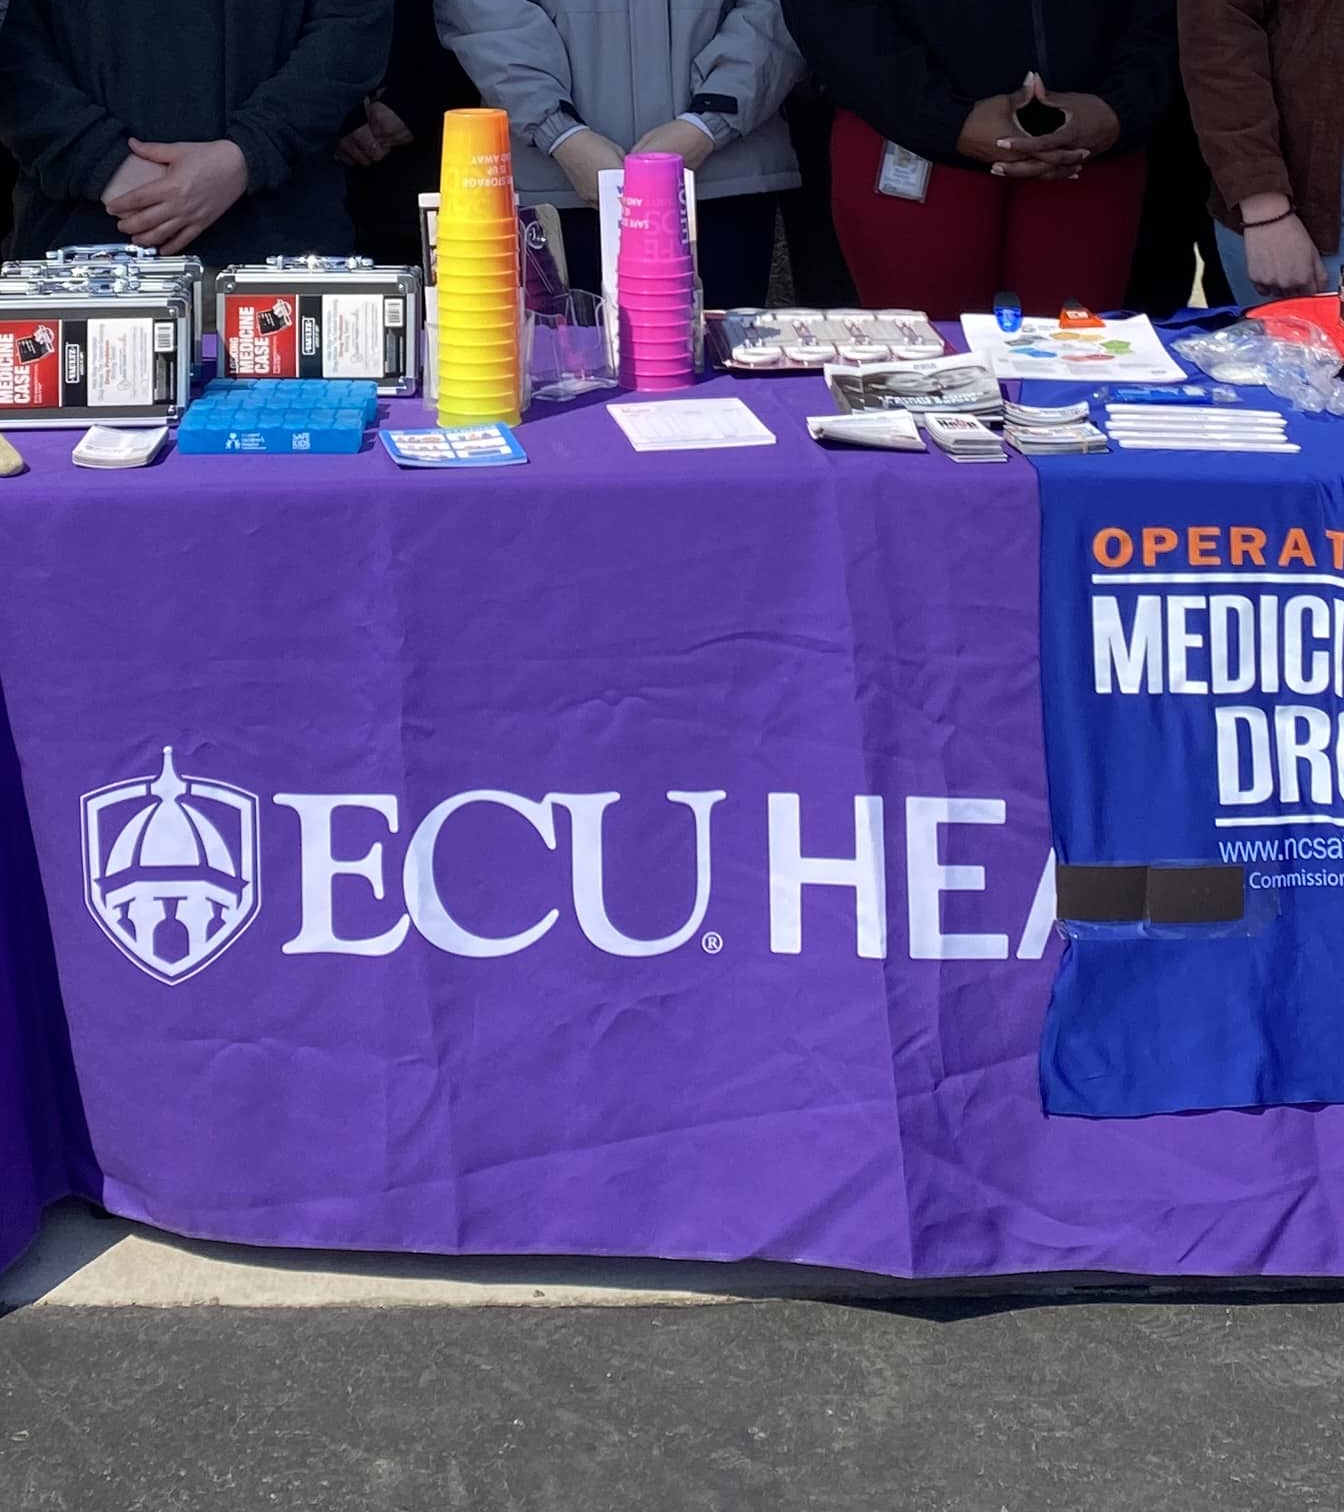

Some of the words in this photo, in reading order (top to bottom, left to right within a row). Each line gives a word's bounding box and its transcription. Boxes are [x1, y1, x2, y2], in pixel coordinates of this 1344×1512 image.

[239, 306, 255, 374] MEDICINE
[255, 336, 270, 374] CASE
[14, 364, 31, 405] CASE
